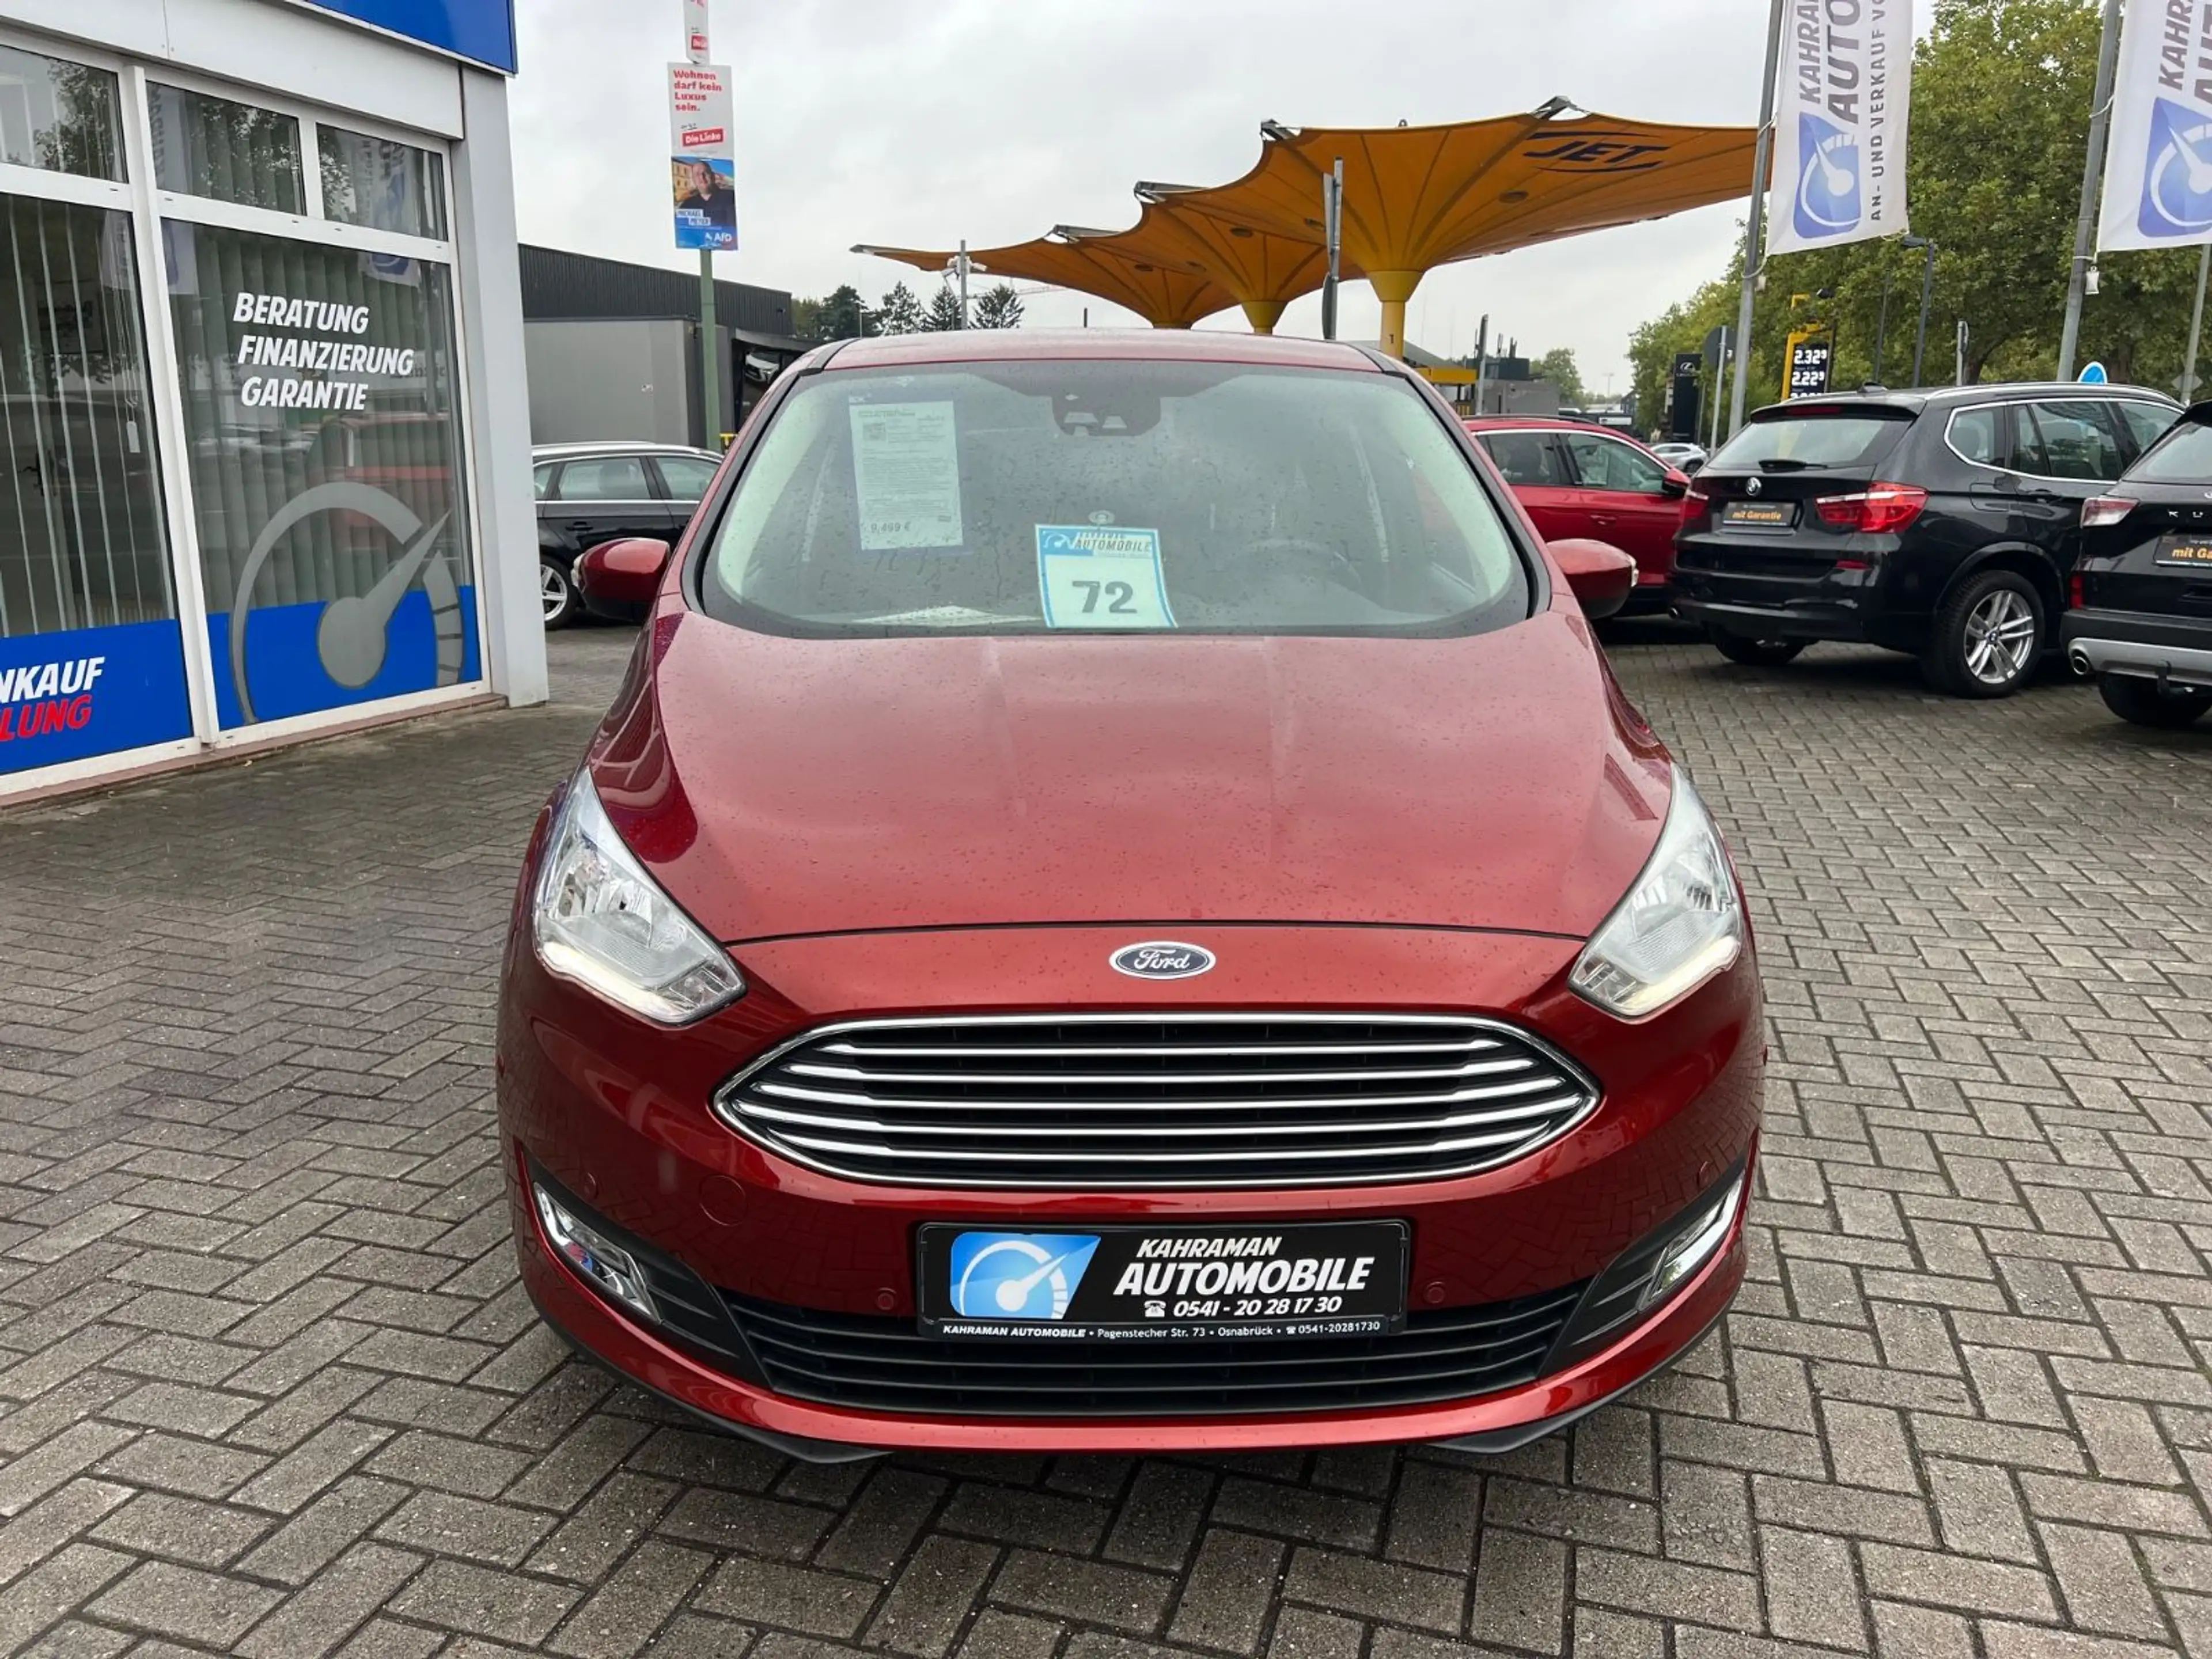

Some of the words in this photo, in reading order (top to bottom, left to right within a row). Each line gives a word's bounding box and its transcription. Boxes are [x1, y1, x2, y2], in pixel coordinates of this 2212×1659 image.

[1797, 0, 1820, 104] KAHRA
[2158, 0, 2193, 90] KAHR
[673, 70, 716, 80] Wohnen
[1870, 29, 1885, 129] VERKAUF
[674, 81, 697, 90] darf
[699, 81, 722, 92] kein
[675, 92, 707, 101] Luxus
[676, 103, 700, 112] sein.
[685, 135, 699, 143] Die
[700, 131, 722, 142] Linke
[1522, 141, 1671, 163] JET
[1870, 135, 1884, 178] UND
[233, 292, 369, 334] BERATUNG
[237, 335, 415, 376] FINANZIERUNG
[241, 376, 369, 410] GARANTIE
[1732, 510, 1747, 518] mit
[1747, 510, 1781, 520] Garantie
[1074, 539, 1152, 552] AUTOMOBILE
[2171, 547, 2194, 558] mit
[1072, 580, 1138, 614] 72
[1133, 948, 1191, 970] Ford
[1136, 1236, 1282, 1258] KAHRAMAN
[1112, 1256, 1376, 1296] AUTOMOBILE
[1173, 1300, 1221, 1317] 0541
[1233, 1299, 1262, 1316] 20
[1263, 1298, 1290, 1315] 28
[1293, 1297, 1309, 1314] 17
[1314, 1296, 1343, 1313] 30
[942, 1325, 1008, 1336] KAHRAMAN
[1010, 1328, 1086, 1338] AUTOMOBILE
[1097, 1328, 1168, 1339] Pagenstecher
[1170, 1327, 1189, 1338] Str.
[1192, 1327, 1206, 1337] 73
[1217, 1325, 1273, 1337] Osnabrück
[1298, 1320, 1381, 1335] 0541-20281730
